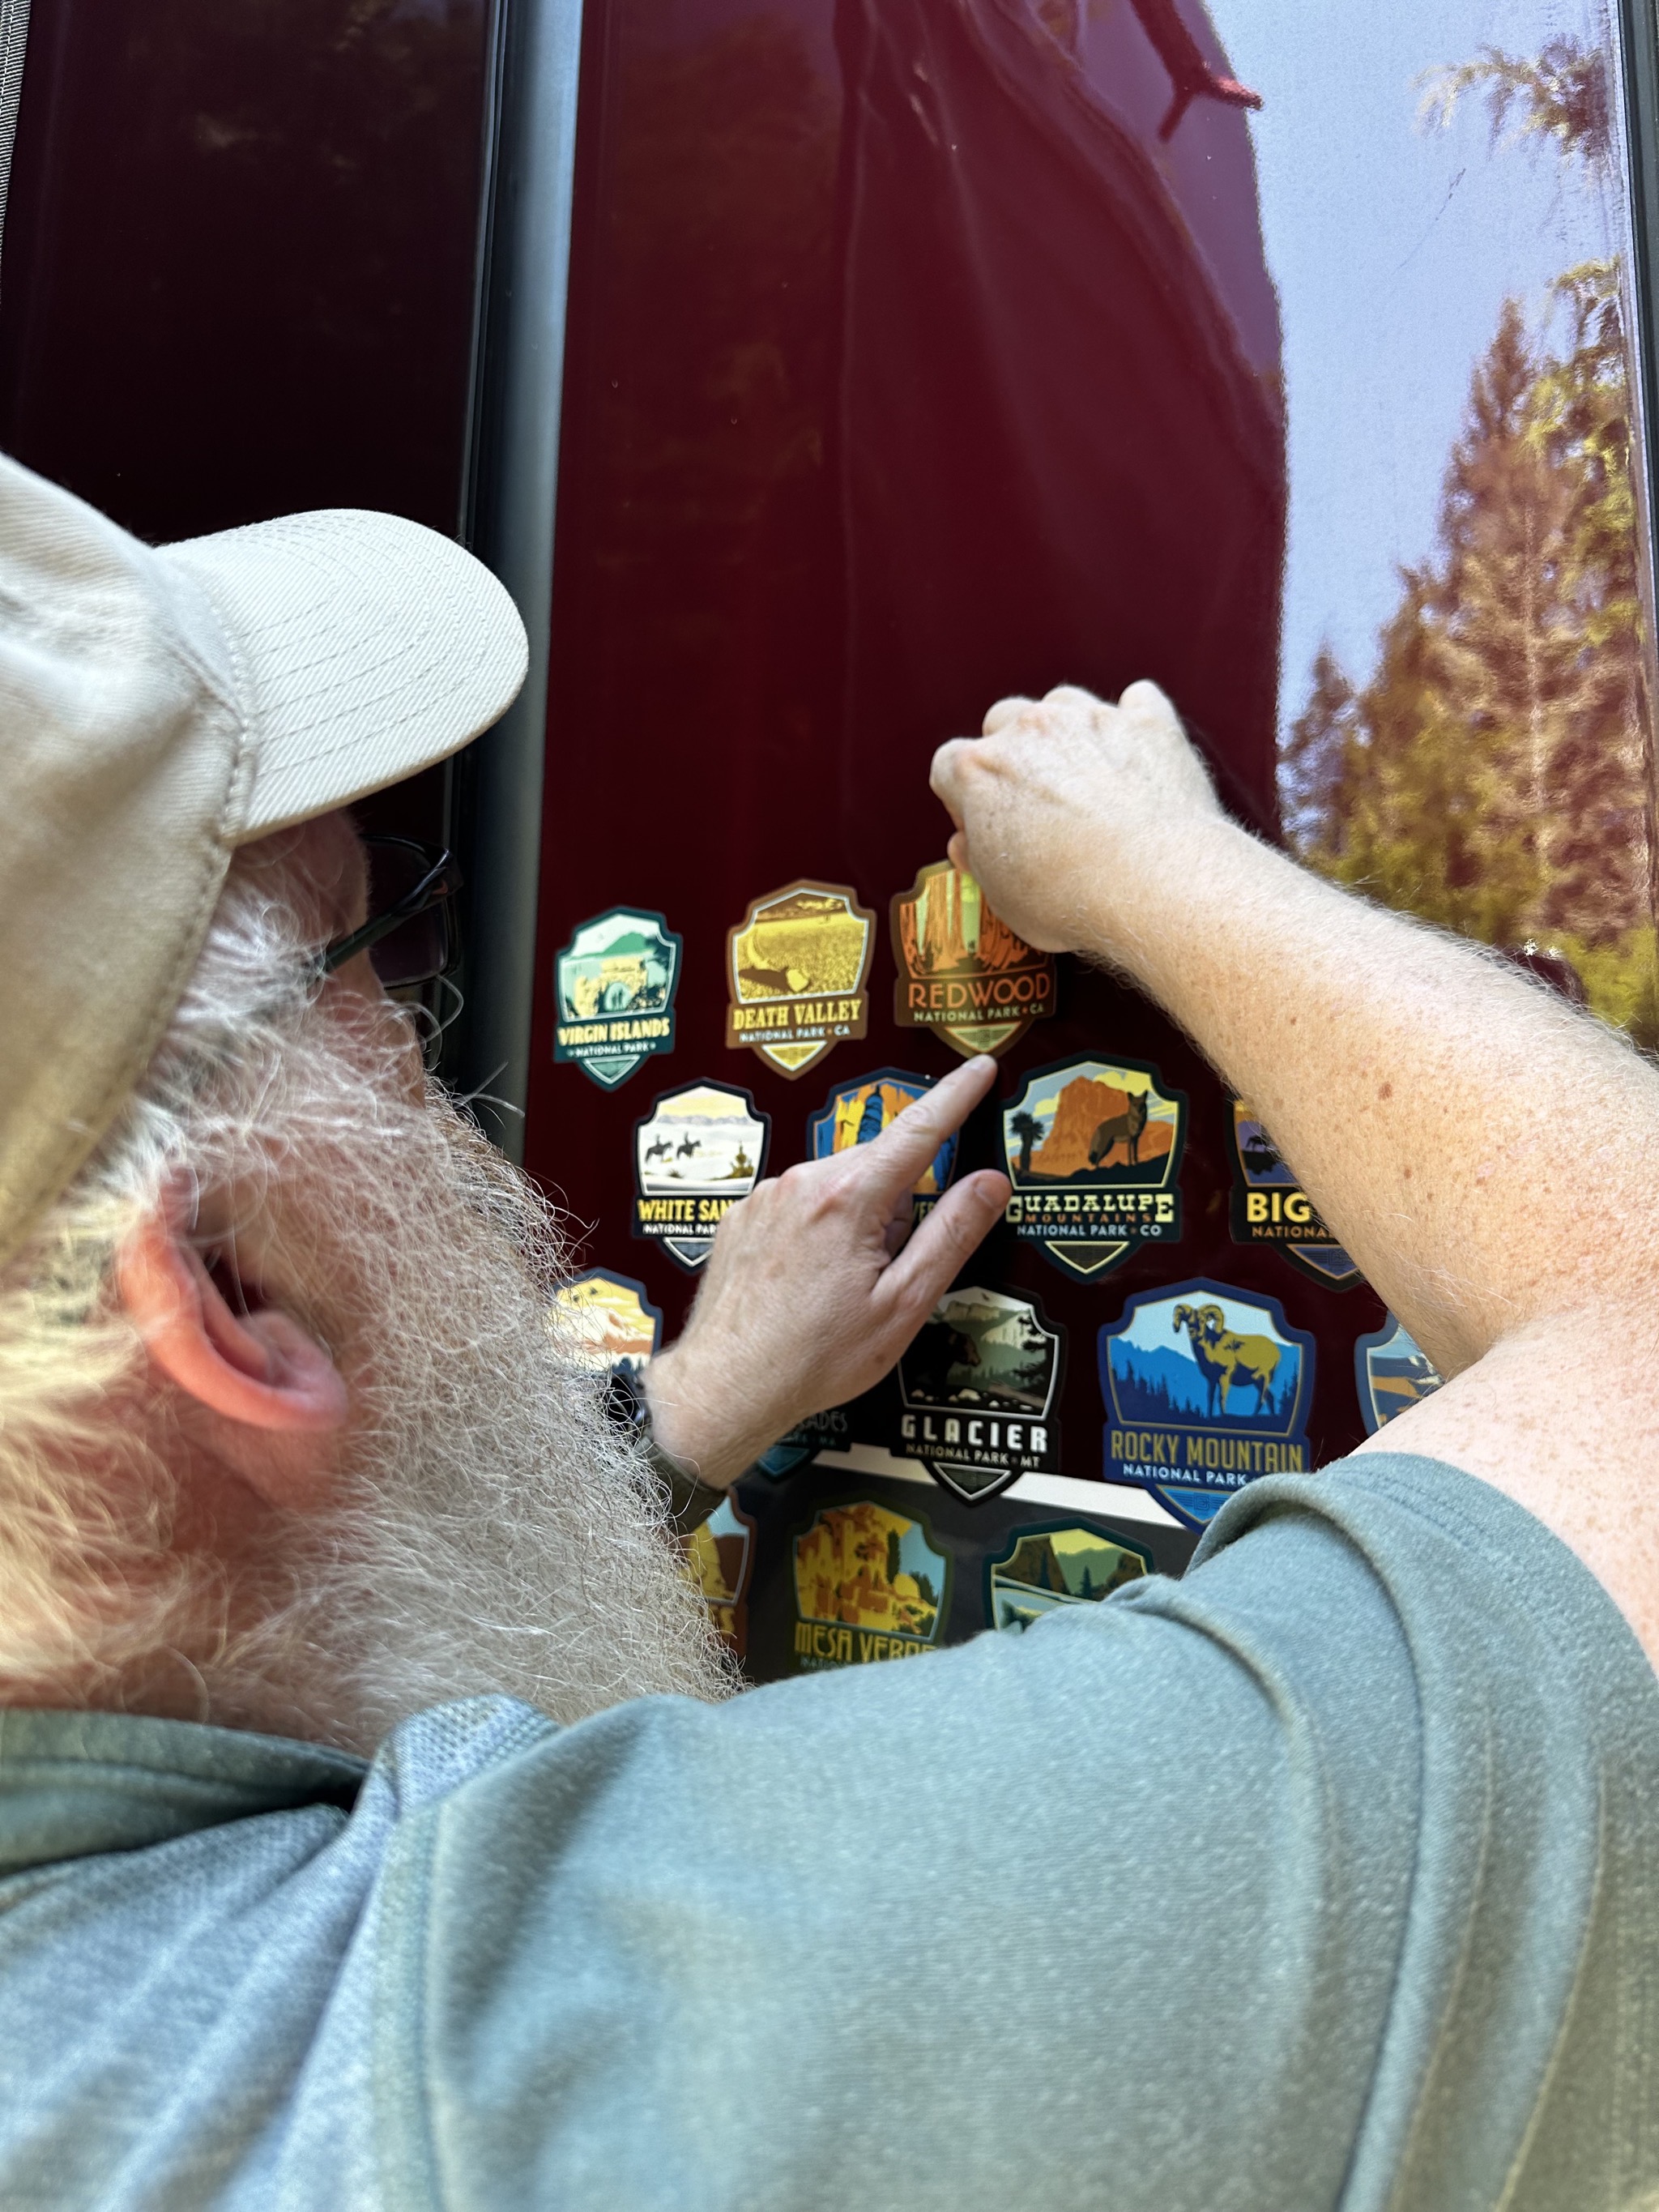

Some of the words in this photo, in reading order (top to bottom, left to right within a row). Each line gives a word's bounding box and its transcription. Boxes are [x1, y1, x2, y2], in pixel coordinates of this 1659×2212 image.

[908, 972, 1051, 1009] REDWOOD
[733, 1005, 790, 1030] DEATH
[793, 998, 862, 1025] VALLEY
[913, 1009, 984, 1023] NATIONAL
[987, 1006, 1021, 1019] PARK
[1030, 1003, 1043, 1014] CA
[557, 1024, 608, 1046] VIRGIN
[609, 1017, 670, 1041] ISLANDS
[739, 1029, 795, 1043] NATIONAL
[796, 1027, 825, 1039] PARK
[834, 1024, 851, 1036] CA
[575, 1043, 621, 1057] NATIONAL
[622, 1040, 649, 1053] PARK
[637, 1199, 696, 1222] WHITE
[698, 1199, 735, 1222] SAN
[1005, 1193, 1174, 1223] GUADALUPE
[1025, 1213, 1152, 1224] MOUNTAINS
[1247, 1192, 1311, 1223] BIG
[642, 1223, 694, 1235] NATIONAL
[695, 1223, 717, 1235] PAR
[1017, 1224, 1086, 1236] NATIONAL
[1090, 1224, 1128, 1236] PARK
[1140, 1224, 1162, 1236] CO
[901, 1414, 1047, 1453] GLACIER
[906, 1443, 971, 1460] NATIONAL
[974, 1450, 1009, 1465] PARK
[1020, 1455, 1041, 1468] MT
[1111, 1429, 1179, 1464] ROCKY
[1186, 1435, 1303, 1474] MOUNTAIN
[1123, 1463, 1201, 1484] NATIONAL
[1206, 1471, 1248, 1486] PARK
[795, 1621, 853, 1661] MESA
